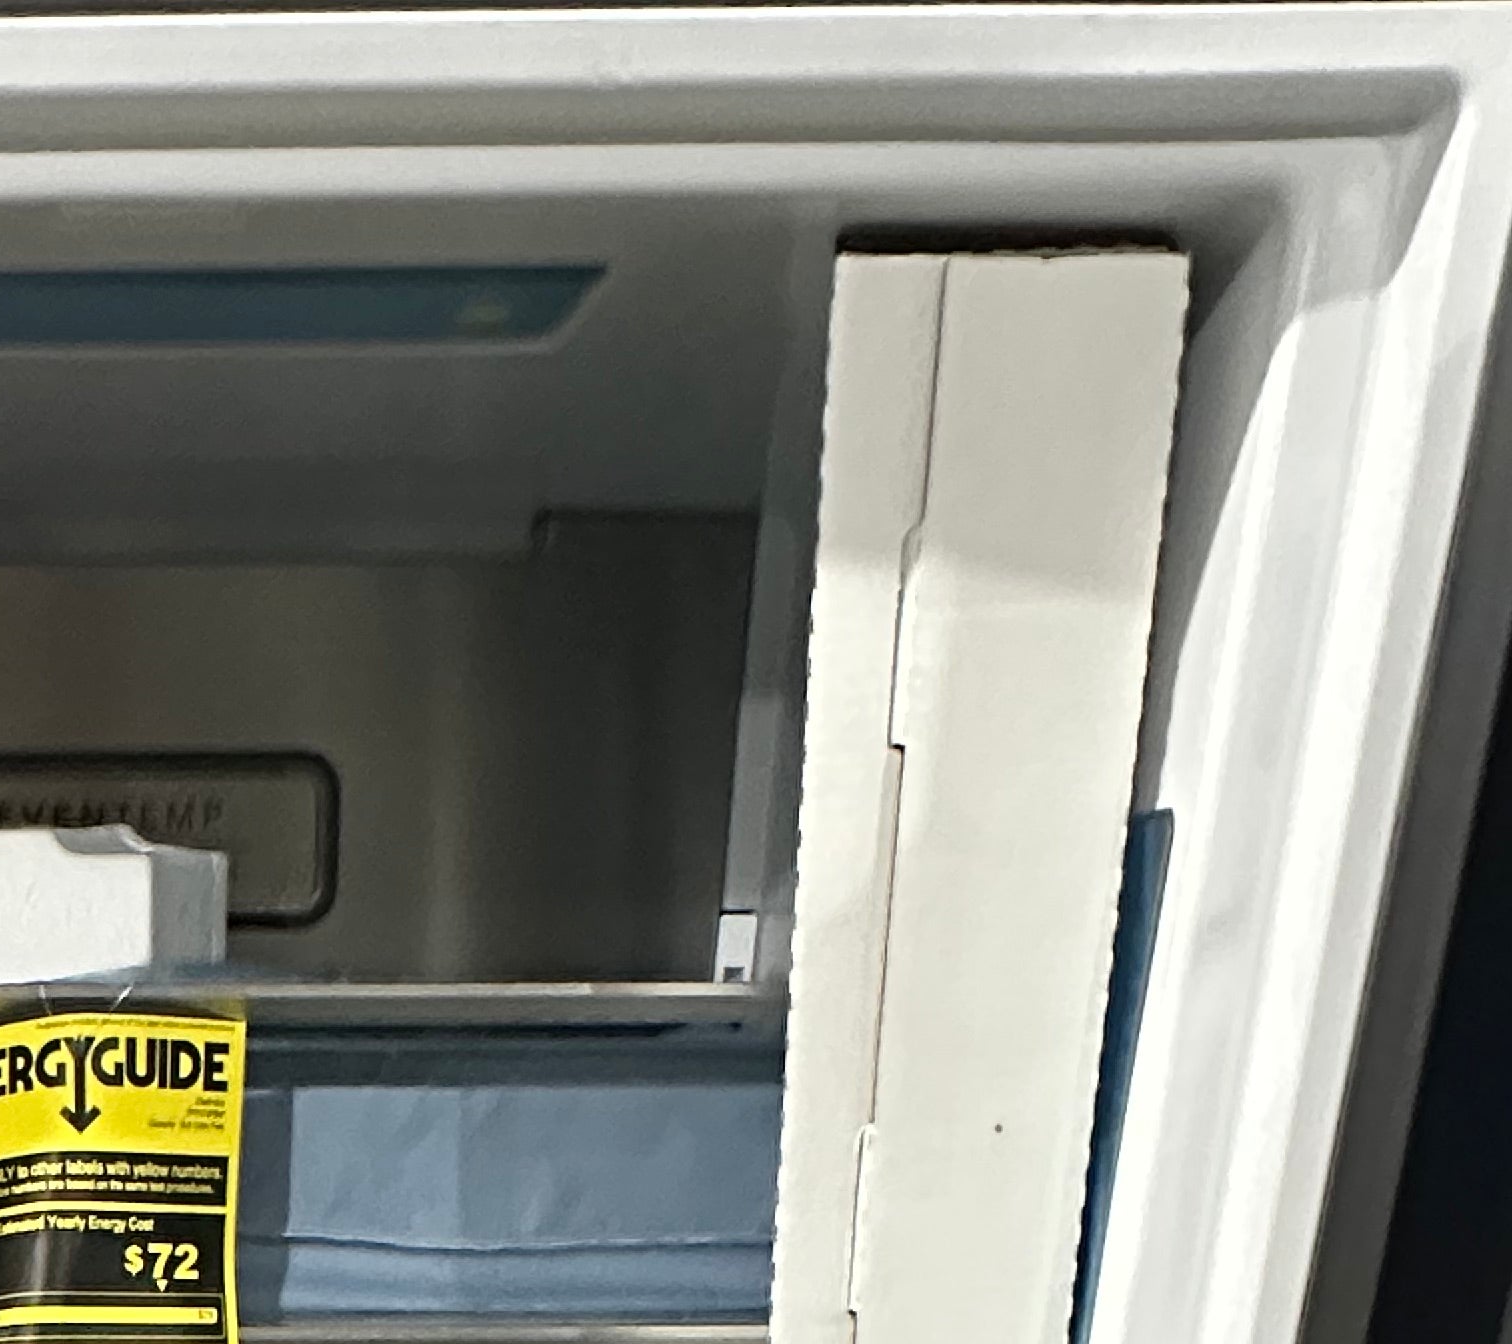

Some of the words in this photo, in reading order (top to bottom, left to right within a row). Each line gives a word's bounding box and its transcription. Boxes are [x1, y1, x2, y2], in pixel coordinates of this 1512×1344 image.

[46, 1214, 86, 1233] Yearly
[88, 1214, 127, 1233] Energy
[128, 1216, 154, 1231] Cost
[124, 1243, 200, 1280] $72
